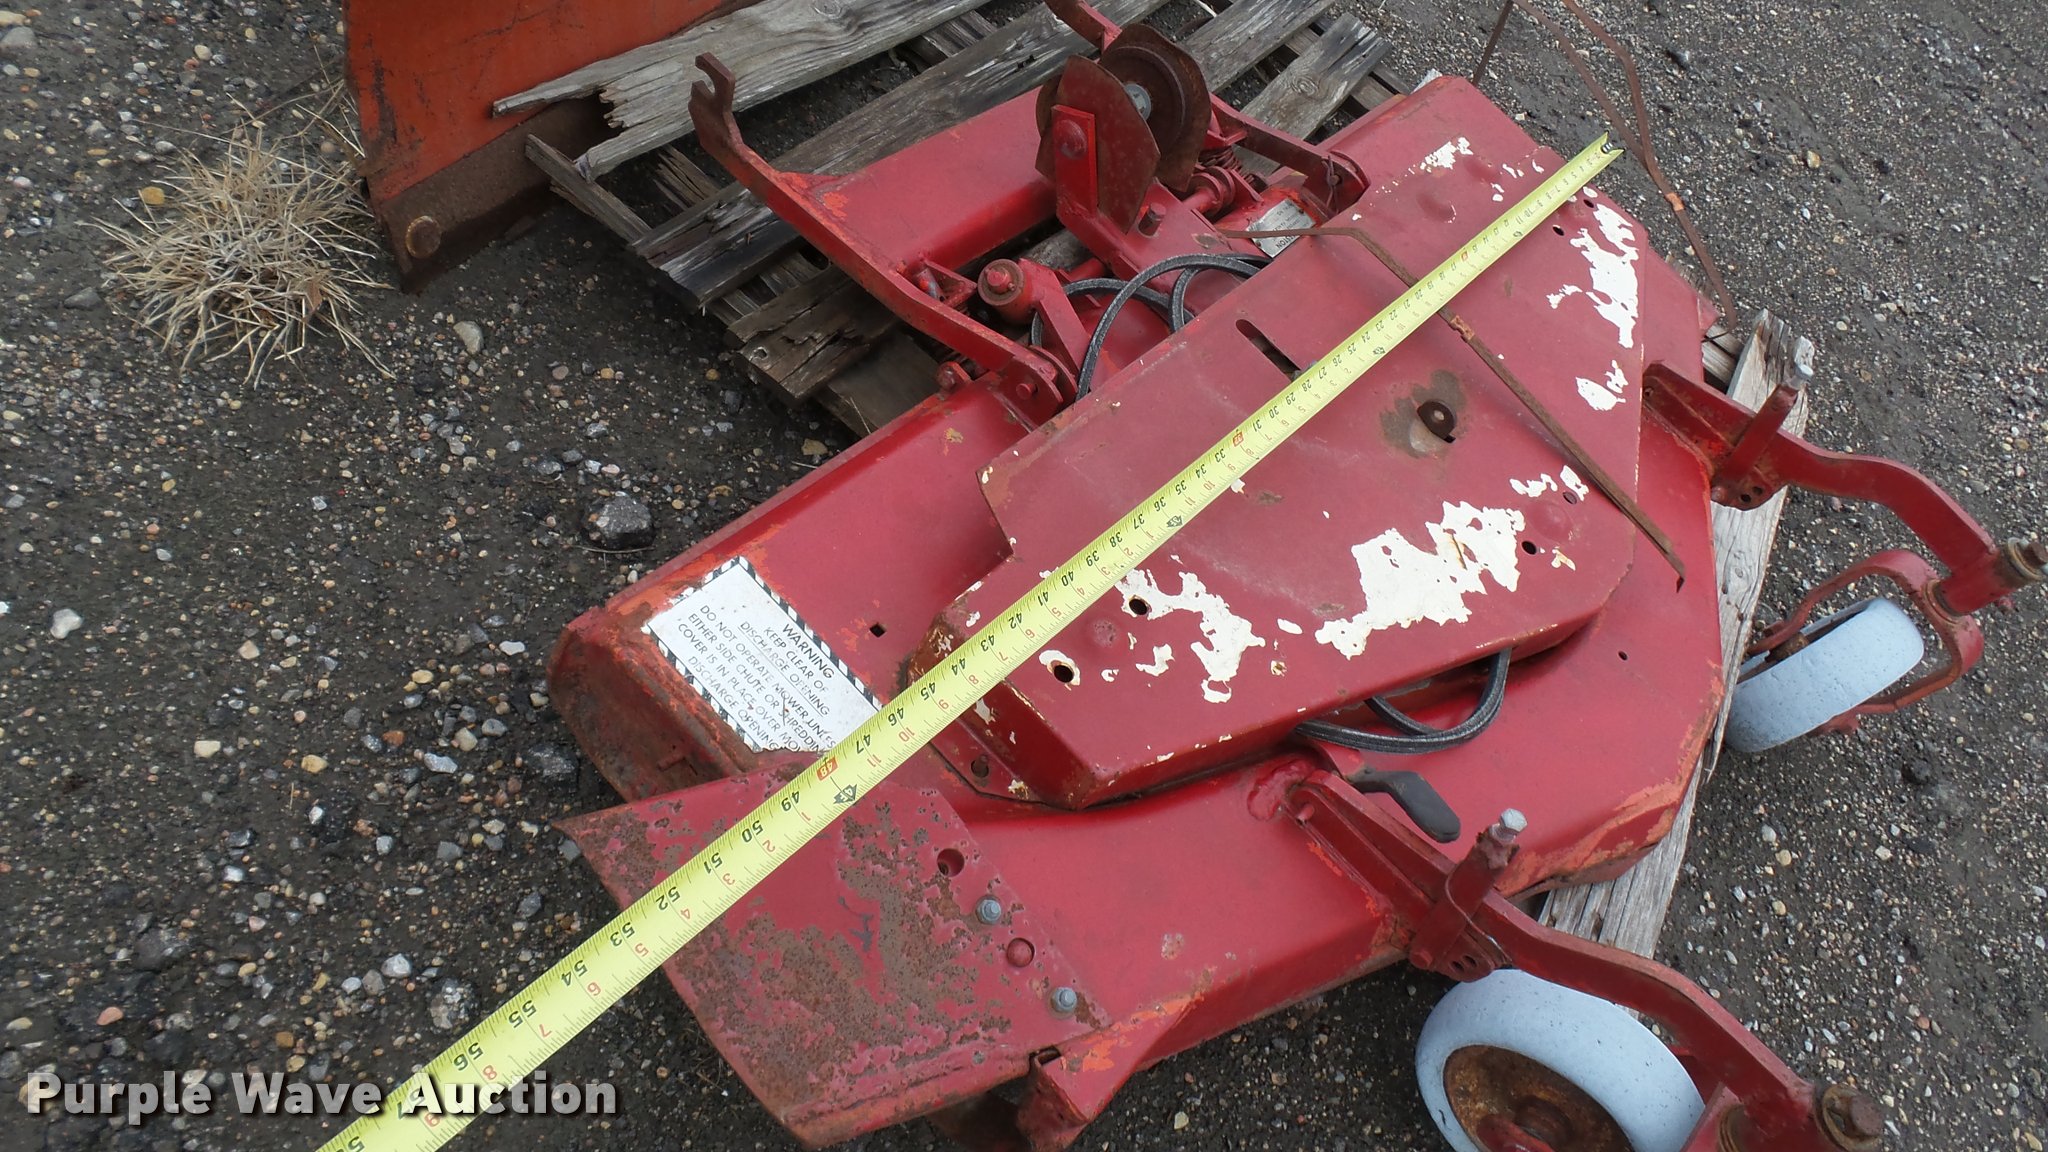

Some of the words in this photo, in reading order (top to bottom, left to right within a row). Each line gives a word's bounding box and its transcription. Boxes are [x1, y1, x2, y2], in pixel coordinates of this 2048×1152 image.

[1414, 288, 1423, 300] 20
[1403, 298, 1411, 310] 21
[1388, 309, 1398, 321] 22
[1375, 319, 1385, 332] 23
[1361, 330, 1371, 343] 24
[1347, 342, 1357, 355] 25
[1332, 354, 1342, 367] 26
[1318, 366, 1327, 380] 27
[1301, 378, 1312, 392] 28
[1285, 391, 1296, 406] 29
[1268, 405, 1280, 419] 30
[1252, 419, 1262, 432] 31
[1214, 448, 1226, 463] 33
[1195, 463, 1207, 479] 34
[1227, 463, 1237, 473] 9
[1175, 479, 1187, 496] 35
[1202, 480, 1216, 491] 10
[1153, 496, 1166, 512] 36
[1184, 496, 1196, 507] 11
[1133, 513, 1145, 530] 37
[1109, 531, 1123, 548] 38
[1085, 550, 1100, 567] 39
[1121, 546, 1134, 559] 2
[1061, 571, 1074, 587] 40
[1098, 566, 1111, 578] 3
[1037, 591, 1049, 607] 41
[1076, 587, 1086, 598] 4
[1008, 612, 1022, 629] 42
[1048, 606, 1063, 620] 5
[980, 634, 995, 652] 43
[1021, 628, 1036, 642] 6
[737, 621, 790, 672] DISCHARGE
[782, 623, 835, 679] WARNING
[688, 613, 718, 644] EITHER
[715, 642, 737, 664] SIDE
[736, 664, 766, 694] CHUTE
[764, 694, 780, 710] OR
[699, 604, 717, 622] DO
[715, 621, 738, 642] NOT
[735, 642, 774, 683] OPERATE
[771, 682, 809, 720] MOWER
[763, 626, 787, 648] KEEP
[785, 650, 815, 680] CLEAR
[813, 679, 829, 692] OF
[998, 651, 1009, 664] 7
[951, 657, 966, 676] 44
[678, 623, 708, 655] COVER
[706, 653, 718, 664] IS
[716, 664, 730, 677] IN
[727, 676, 757, 708] PLACE
[755, 705, 781, 733] OVER
[688, 655, 740, 709] DISCHARGE
[965, 674, 980, 688] 8
[920, 682, 936, 701] 45
[935, 698, 950, 713] 9
[887, 707, 904, 727] 46
[898, 726, 916, 743] 10
[856, 733, 871, 754] 47
[866, 753, 882, 768] 11
[817, 760, 837, 778] 48
[781, 790, 800, 812] 49
[741, 819, 764, 843] 50
[761, 839, 776, 855] 2
[703, 852, 723, 874] 51
[722, 872, 736, 886] 3
[655, 886, 681, 911] 52
[679, 907, 691, 920] 4
[609, 921, 635, 947] 53
[634, 942, 650, 958] 5
[561, 959, 588, 987] 54
[586, 981, 602, 997] 6
[508, 999, 537, 1029] 55
[538, 1023, 553, 1038] 7
[450, 1042, 484, 1071] 56
[482, 1064, 498, 1081] 8
